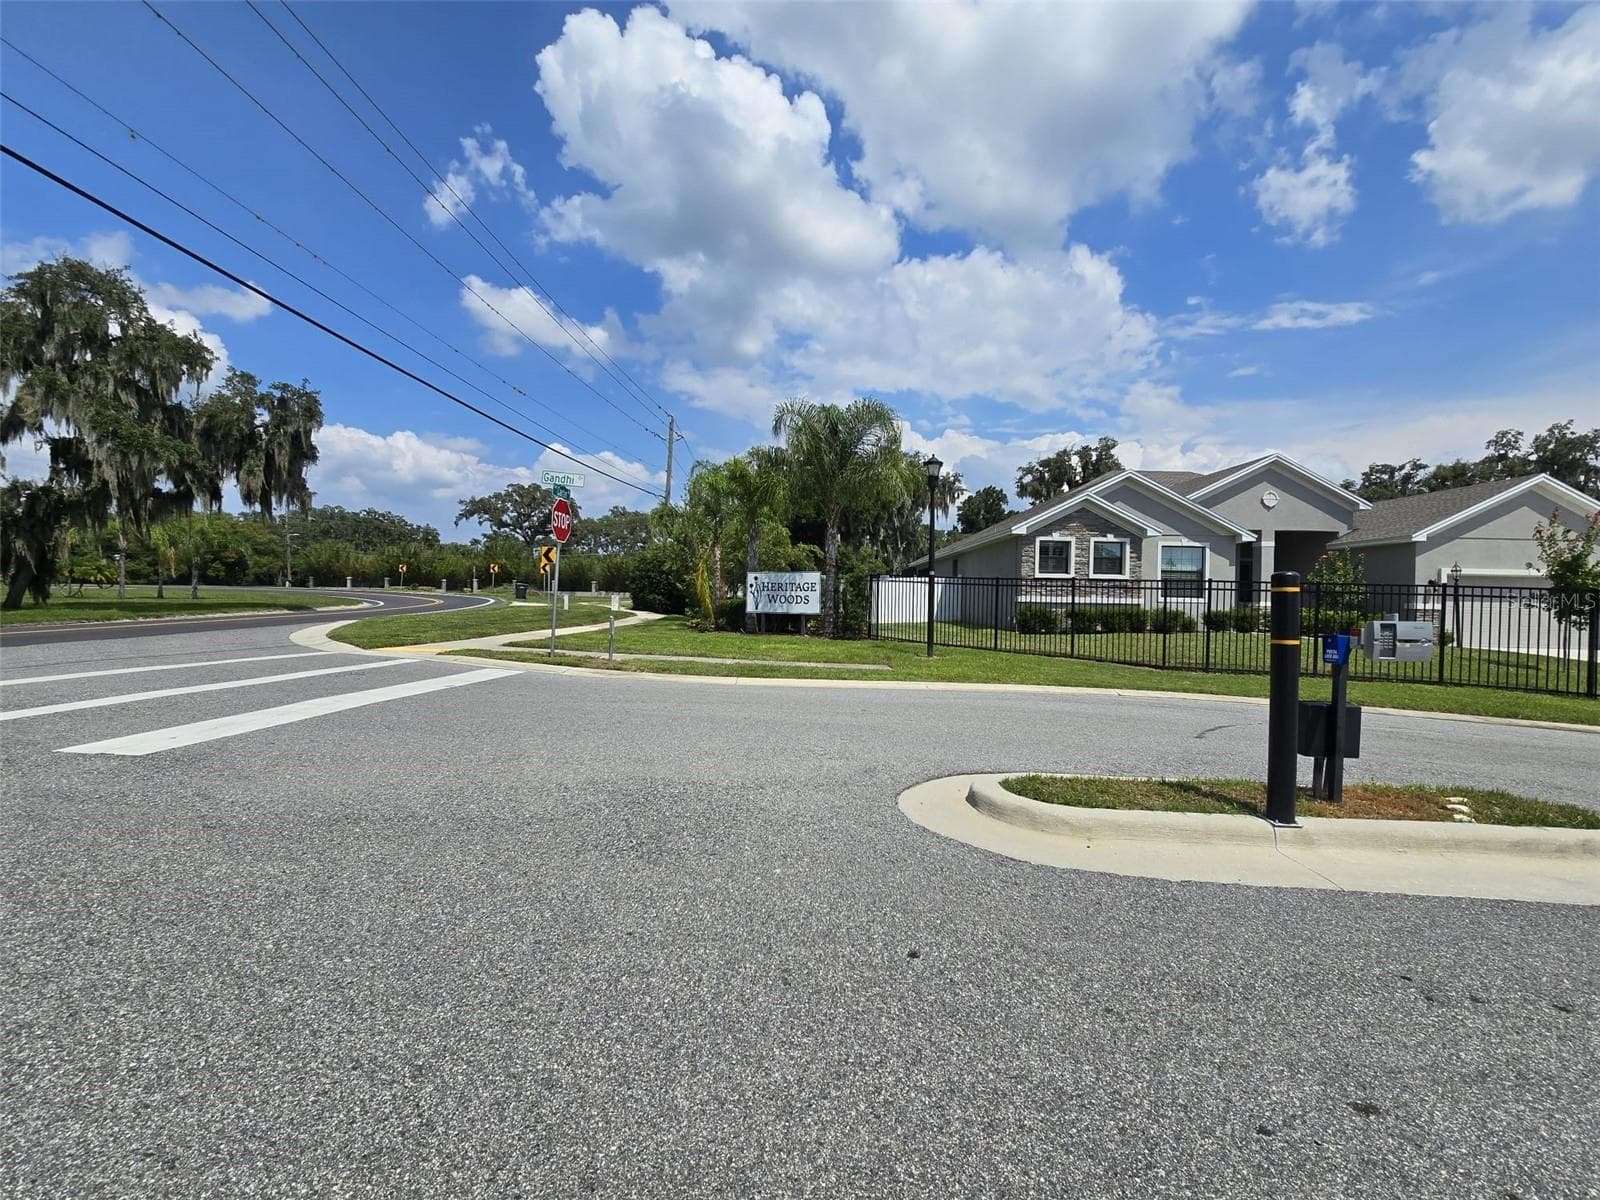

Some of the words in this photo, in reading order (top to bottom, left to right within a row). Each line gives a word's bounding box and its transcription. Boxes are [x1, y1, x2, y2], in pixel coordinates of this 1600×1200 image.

[543, 472, 575, 485] Gandhi
[553, 511, 570, 530] STOP
[761, 582, 817, 592] HERITAGE
[767, 594, 810, 605] WOODS
